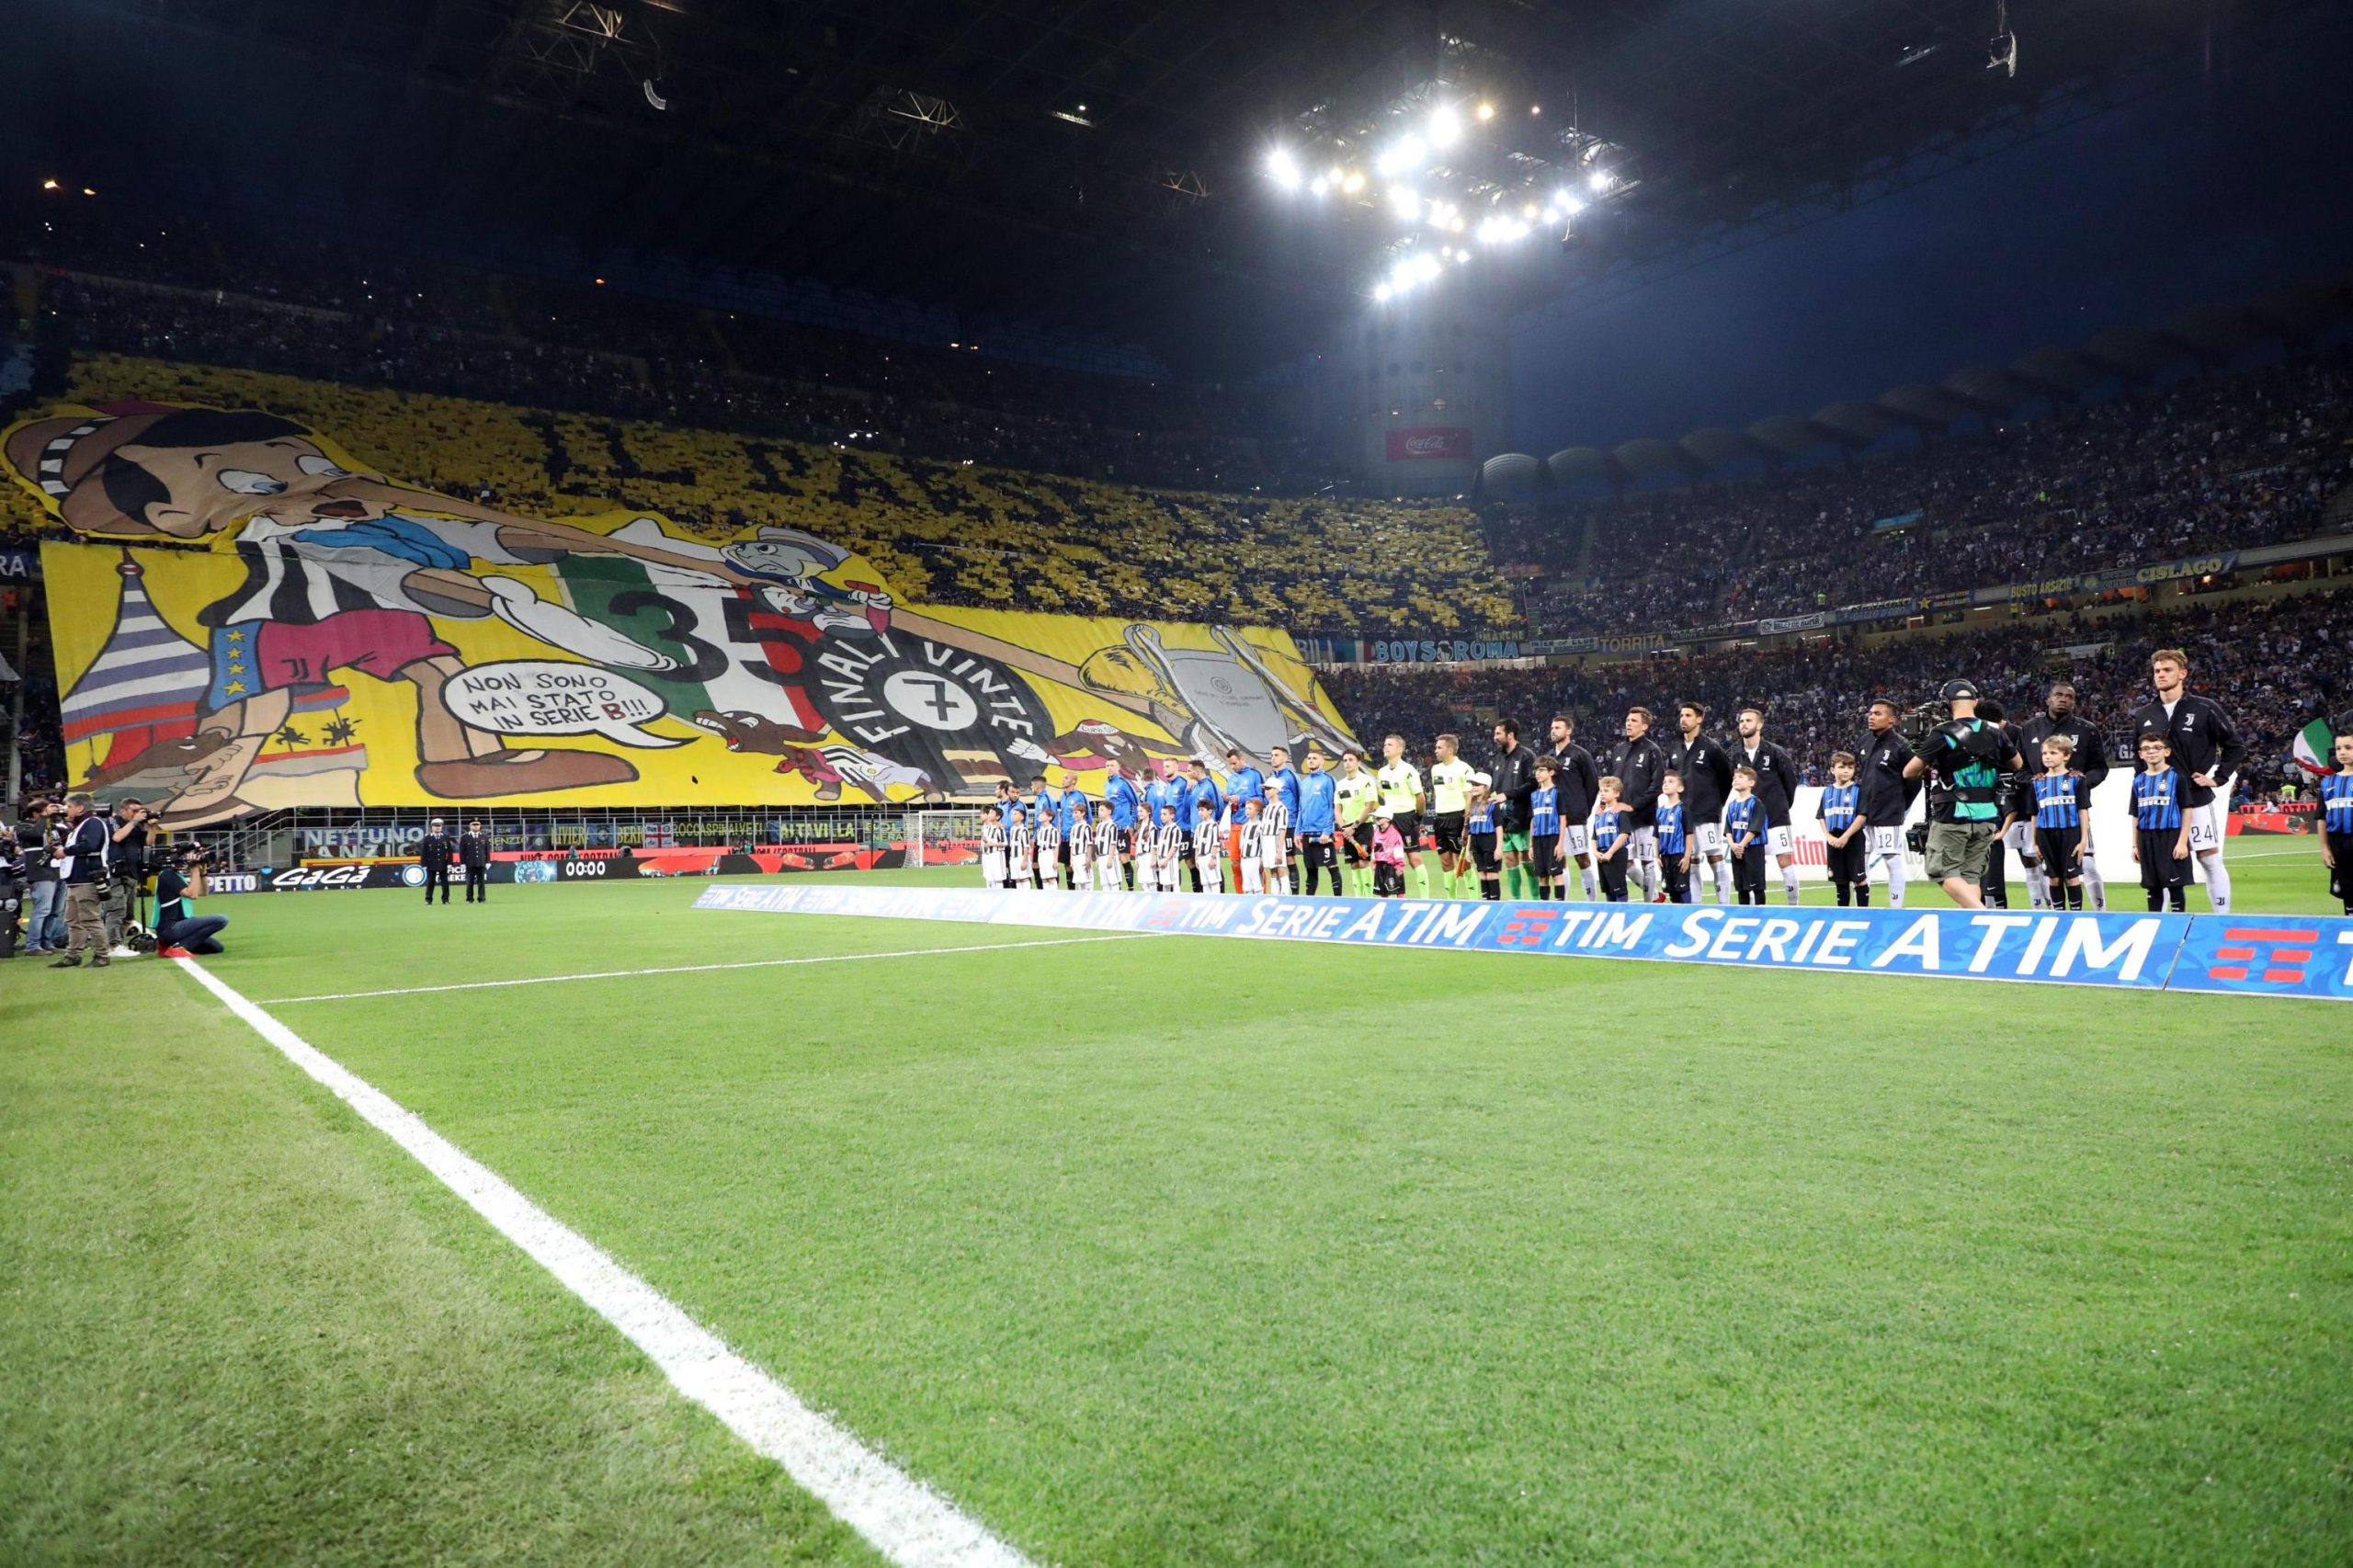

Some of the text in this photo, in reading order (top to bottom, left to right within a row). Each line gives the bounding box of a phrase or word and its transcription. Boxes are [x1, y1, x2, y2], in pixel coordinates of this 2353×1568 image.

[2136, 558, 2221, 582] CISLAGO
[2010, 584, 2038, 598] BUSTO
[1375, 641, 1519, 662] BOYS ROMA
[1600, 635, 1665, 653] TORRITA
[463, 672, 608, 693] NON SONO
[924, 642, 1034, 736] VINTE
[469, 689, 616, 713] MAI STATO
[493, 714, 522, 731] IN
[535, 705, 600, 727] SERIE
[306, 827, 425, 846] NETTUNO
[1571, 835, 1584, 849] 15
[1708, 831, 1716, 844] 6
[1779, 833, 1788, 846] 5
[1878, 834, 1893, 848] 12
[2190, 824, 2213, 843] 24
[1180, 842, 1189, 851] 37
[1324, 847, 1331, 858] 9
[1640, 843, 1654, 856] 17
[566, 860, 606, 877] 00:00
[1178, 900, 1241, 929] TIM
[1235, 897, 1352, 938] SERIE
[1338, 902, 1387, 940] A
[1385, 903, 1493, 946] TIM
[1553, 910, 1654, 950] TIM
[1663, 908, 1871, 966] SERIE
[1870, 915, 1941, 971] A
[1968, 915, 2163, 981] TIM
